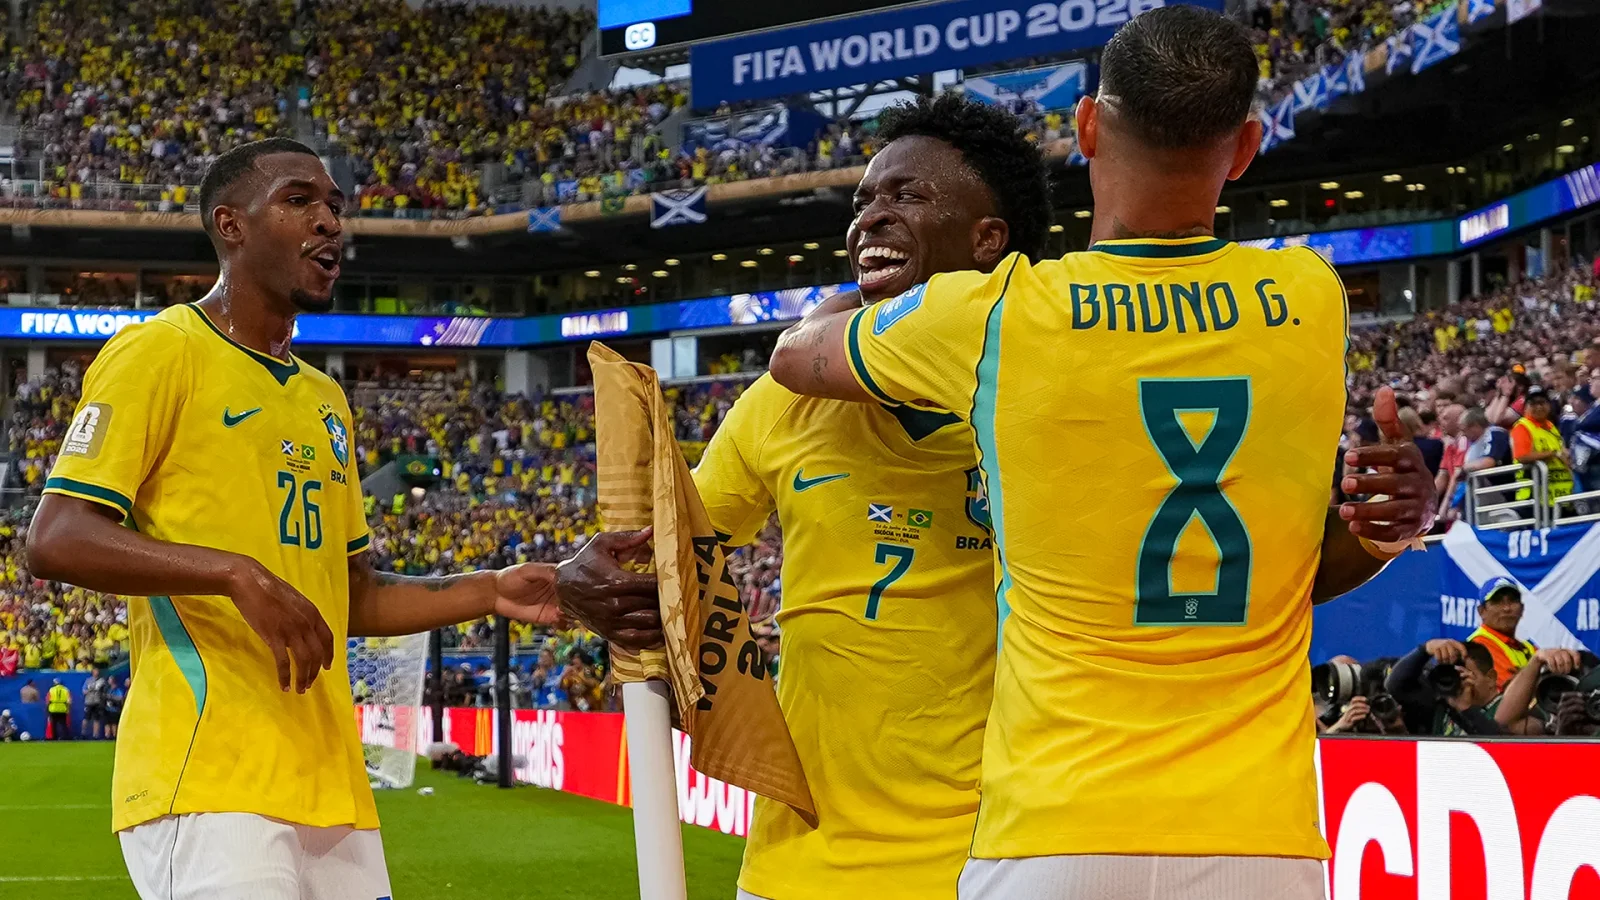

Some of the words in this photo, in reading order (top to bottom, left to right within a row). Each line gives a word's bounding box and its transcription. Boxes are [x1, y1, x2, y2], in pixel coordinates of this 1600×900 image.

[732, 46, 806, 86] FIFA
[808, 24, 941, 72] WORLD
[945, 9, 1021, 50] CUP
[21, 313, 74, 334] FIFA
[75, 314, 155, 335] WOR
[561, 310, 628, 337] MIAMI
[1069, 281, 1239, 333] BRUNO
[1255, 278, 1301, 327] G.
[331, 469, 347, 486] BRA
[1133, 375, 1253, 627] 8
[277, 470, 323, 550] 26
[956, 536, 993, 550] BRA
[864, 541, 915, 620] 7
